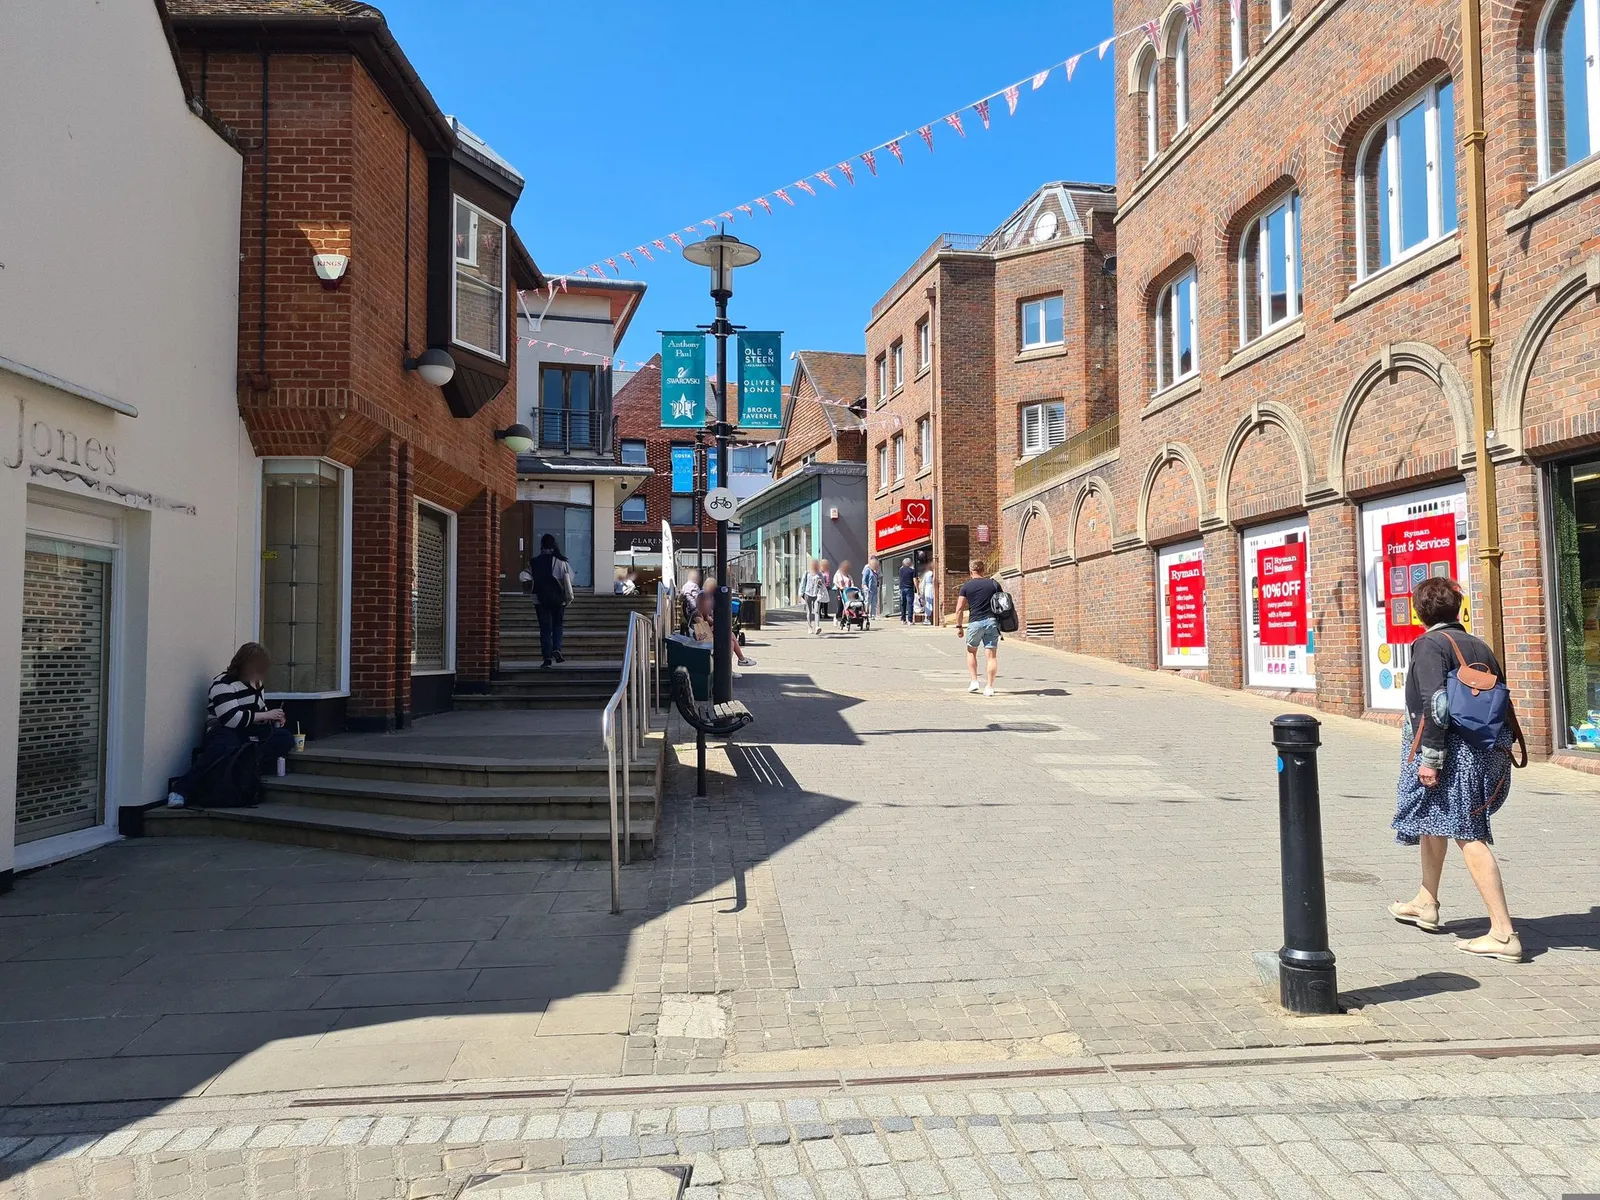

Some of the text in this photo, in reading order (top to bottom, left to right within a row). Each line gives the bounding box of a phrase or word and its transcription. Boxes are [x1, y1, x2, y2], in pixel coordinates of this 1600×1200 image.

[667, 339, 700, 349] Anthony
[675, 349, 692, 357] Paul
[744, 347, 775, 356] OLE &
[744, 356, 774, 364] STEEN
[666, 377, 701, 385] SWAROVSKI
[671, 399, 695, 416] PRET
[3, 395, 117, 476] Jones
[1403, 529, 1430, 538] Ryman
[631, 537, 681, 546] CLARENN
[1387, 537, 1451, 555] Print & Services
[1274, 556, 1297, 565] Ryman
[1171, 568, 1200, 581] Ryman
[1262, 580, 1301, 598] 10% OFF
